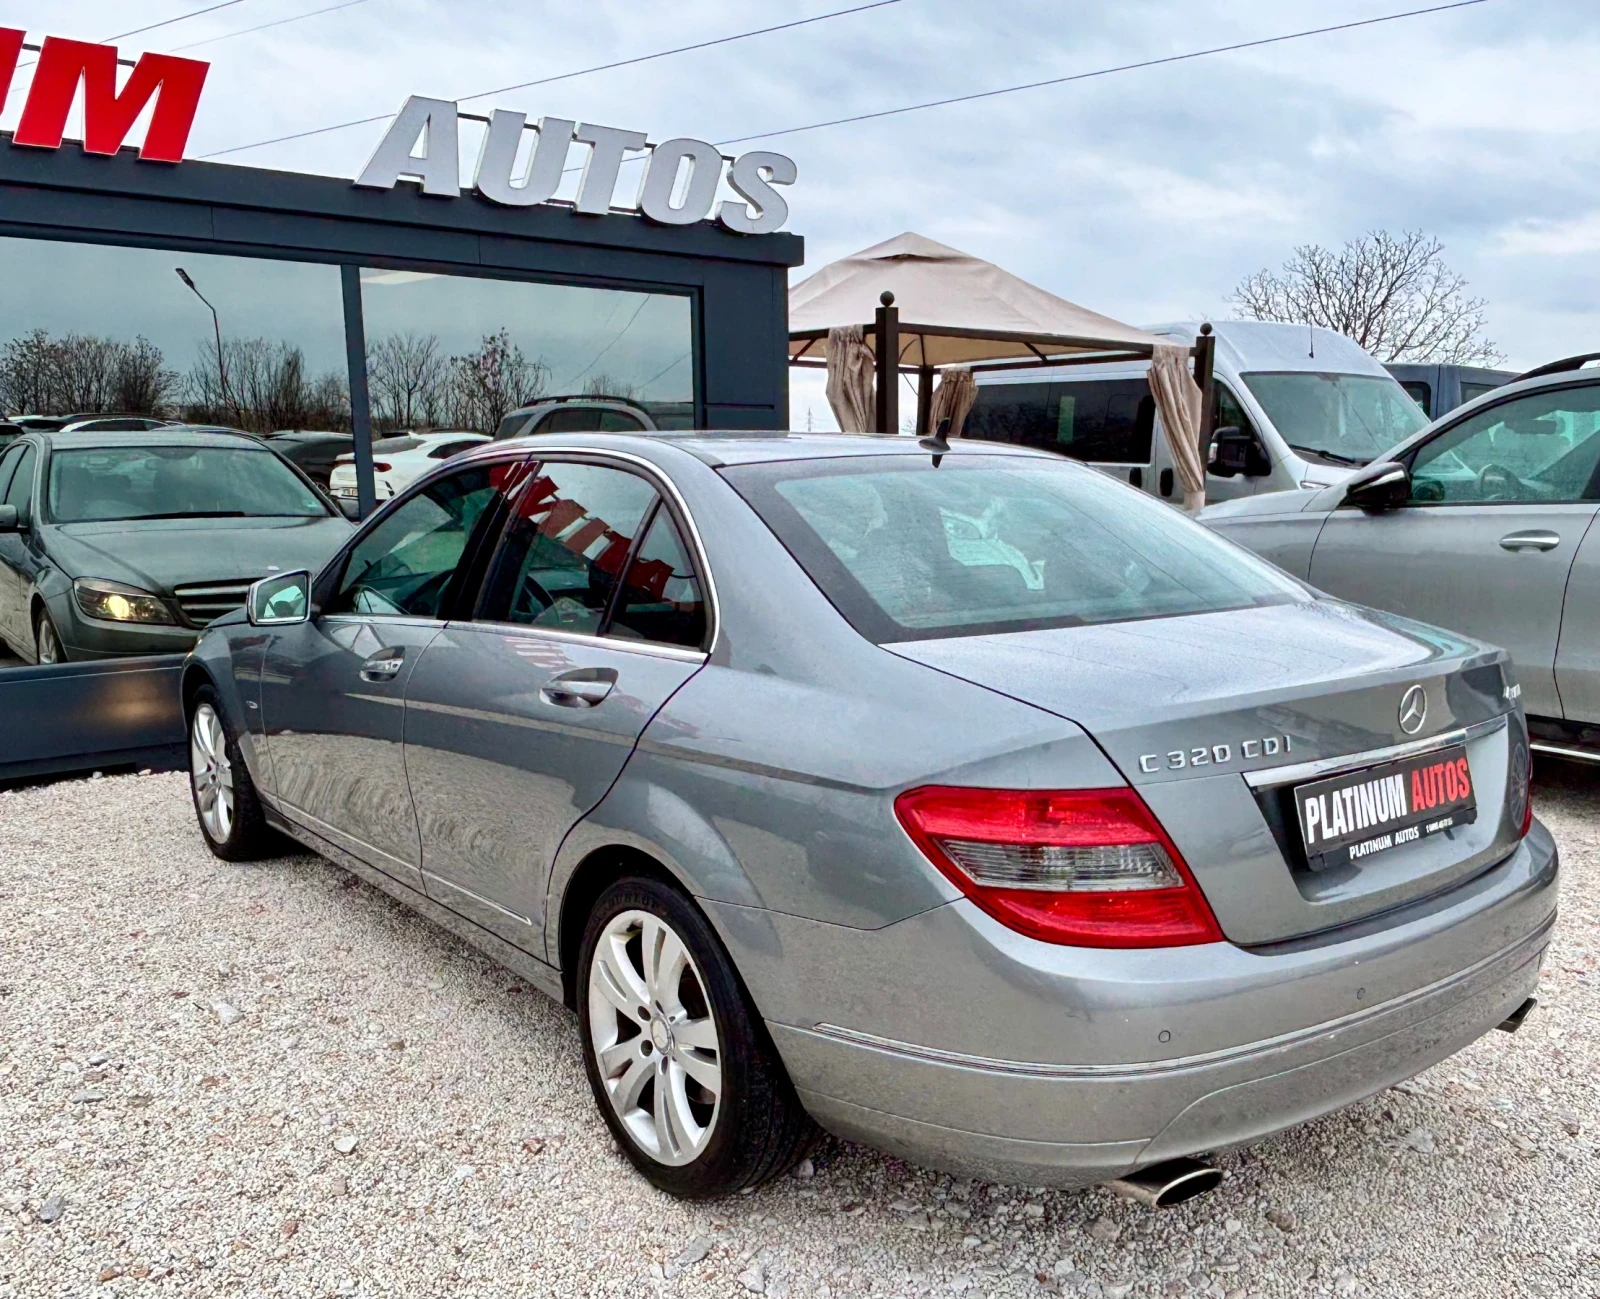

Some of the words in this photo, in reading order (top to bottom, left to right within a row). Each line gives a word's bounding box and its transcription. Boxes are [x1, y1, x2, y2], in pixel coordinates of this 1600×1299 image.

[0, 26, 211, 164] M
[353, 94, 798, 235] AUTOS
[1139, 754, 1160, 773] C
[1167, 744, 1232, 769] 320
[1240, 735, 1292, 759] CDI
[1304, 773, 1408, 844] PLATINUM
[1411, 757, 1470, 812] AUTOS
[1348, 833, 1393, 860] PLATINUM
[1394, 825, 1420, 846] AUTOS
